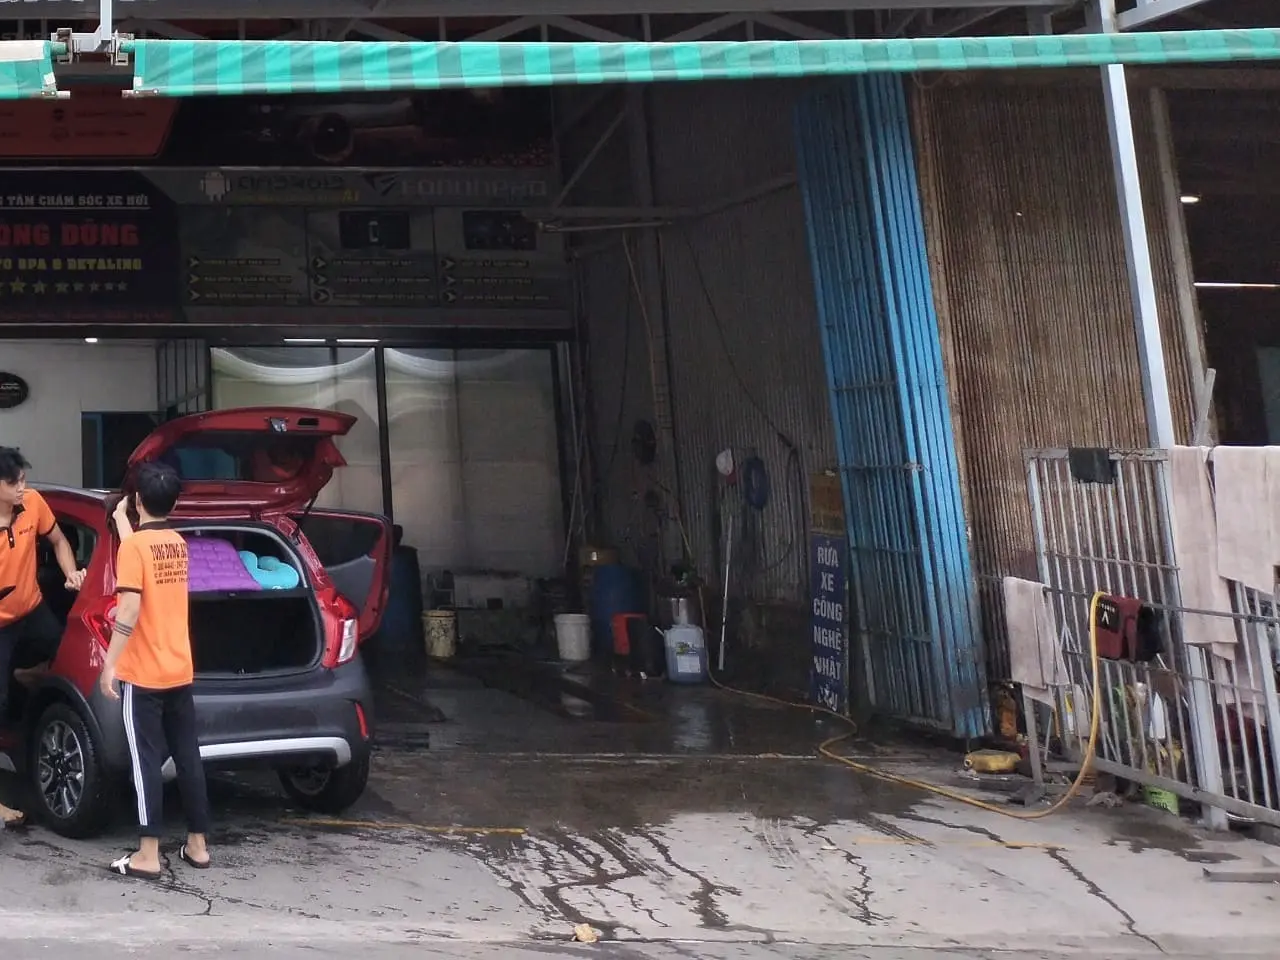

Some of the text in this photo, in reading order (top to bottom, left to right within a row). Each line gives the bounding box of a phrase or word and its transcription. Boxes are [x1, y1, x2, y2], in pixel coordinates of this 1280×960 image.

[6, 194, 35, 207] TÂM
[106, 195, 124, 207] XE
[817, 541, 840, 568] RỬA
[820, 571, 835, 593] XE
[813, 595, 843, 622] CÔNG
[813, 625, 842, 656] NGHỆ
